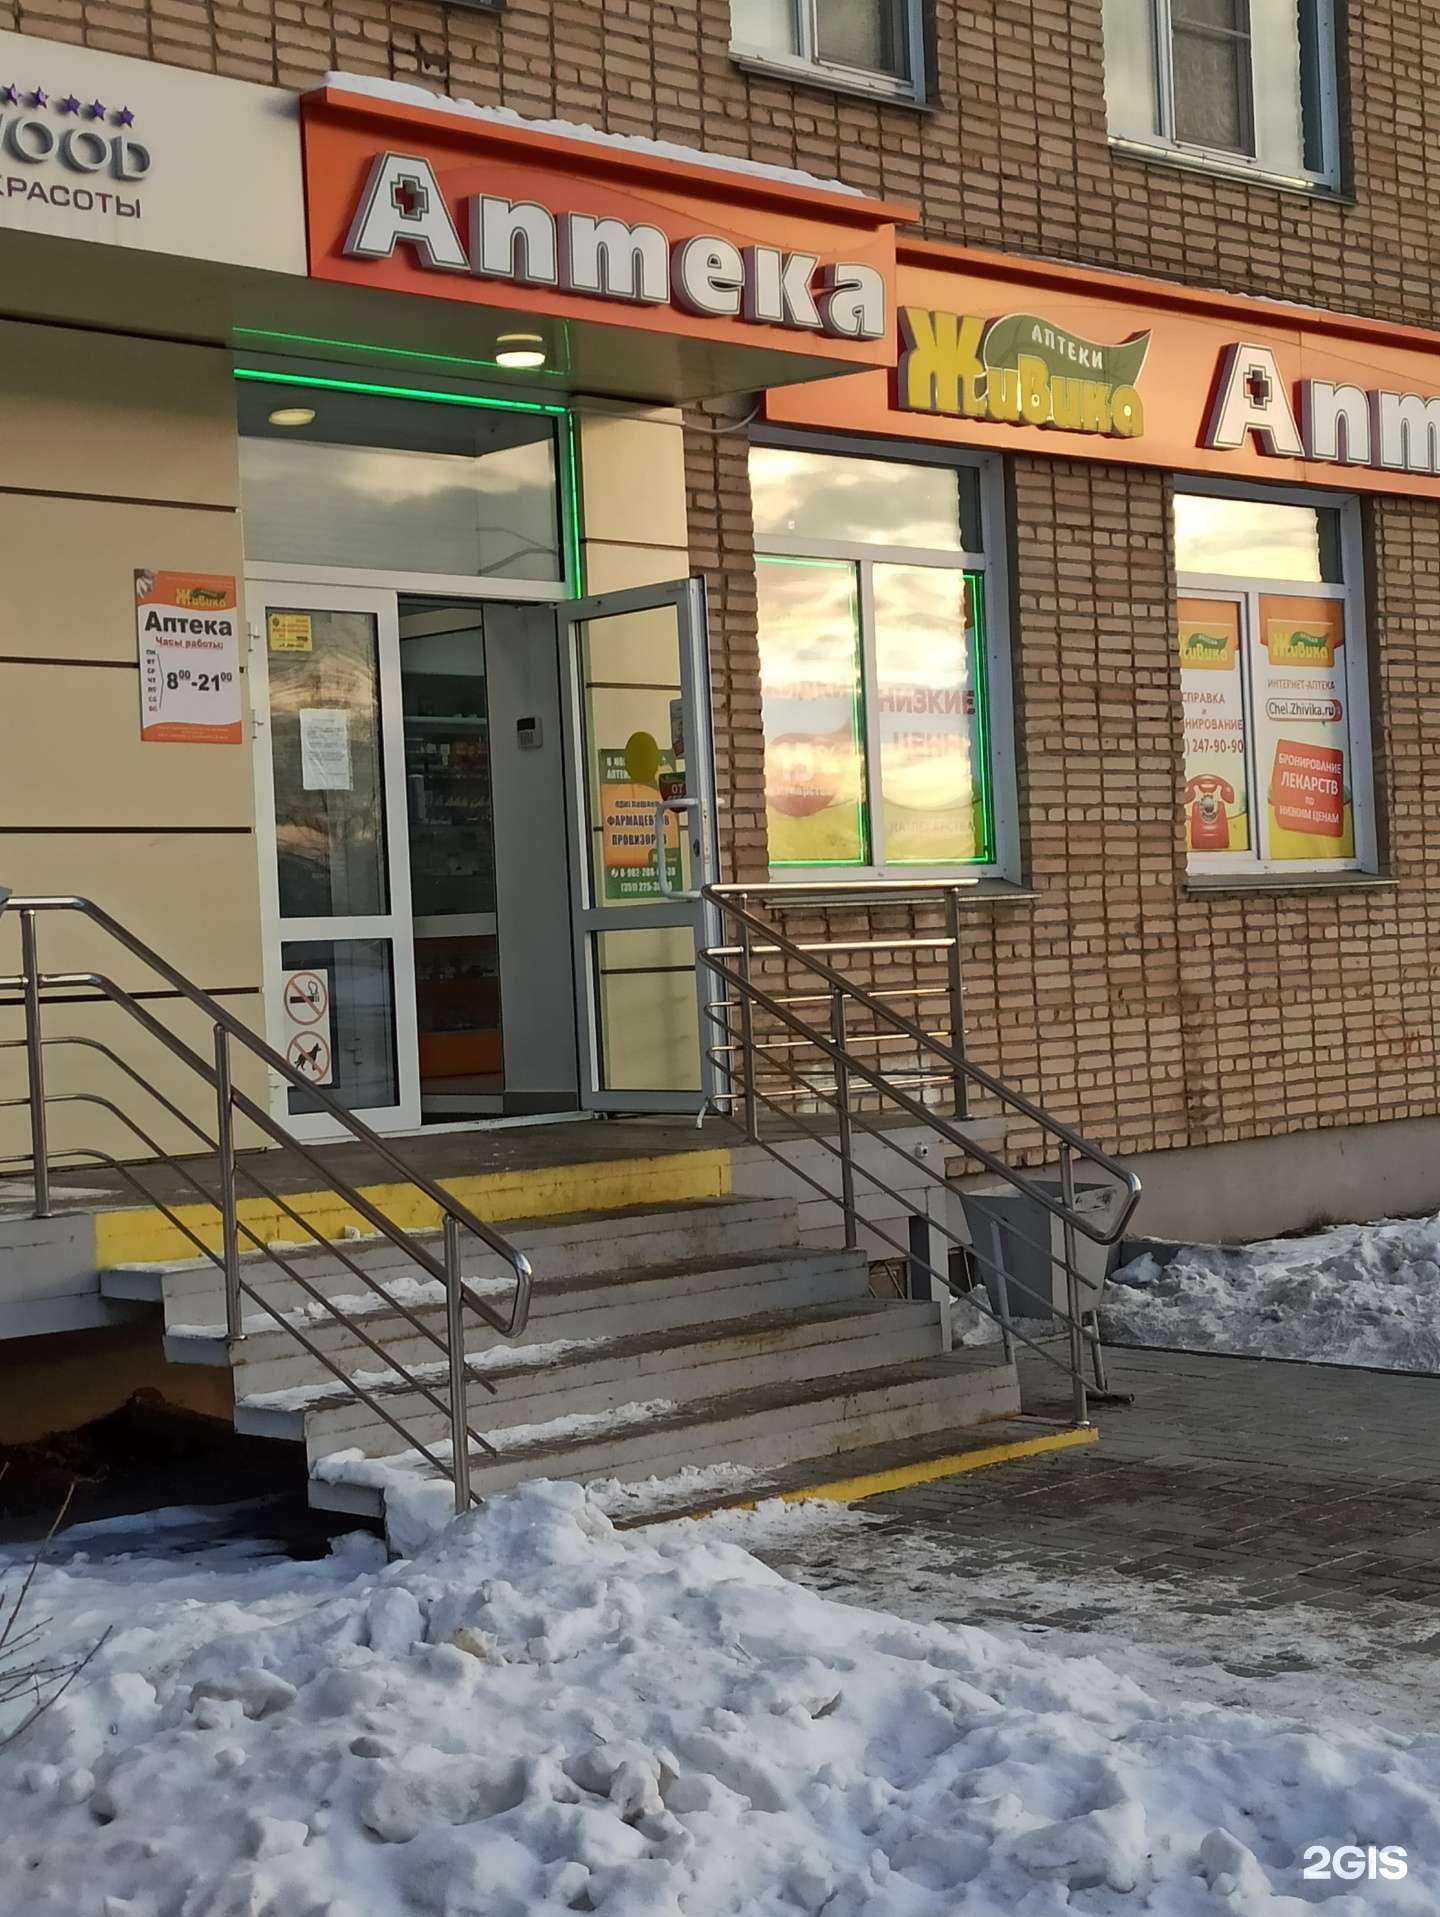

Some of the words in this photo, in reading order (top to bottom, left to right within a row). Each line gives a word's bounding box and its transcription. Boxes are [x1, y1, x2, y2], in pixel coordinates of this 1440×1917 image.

[343, 150, 885, 340] Аптека
[1031, 324, 1103, 370] АПТЕКИ
[898, 305, 1144, 438] Живика
[145, 610, 232, 637] Аптека
[155, 636, 183, 648] Часы
[879, 687, 976, 715] НИЗКИЕ
[1268, 701, 1335, 717] Chel.Zhivika.ru
[1278, 752, 1342, 775] БРОНИРОВАНИЕ
[1281, 771, 1339, 796] ЛЕКАРСТВ
[607, 815, 670, 827] ФАРМАЦЕВВ
[1312, 811, 1339, 825] ЦЕНАМ
[612, 834, 668, 846] ПРОВИЗОРВ
